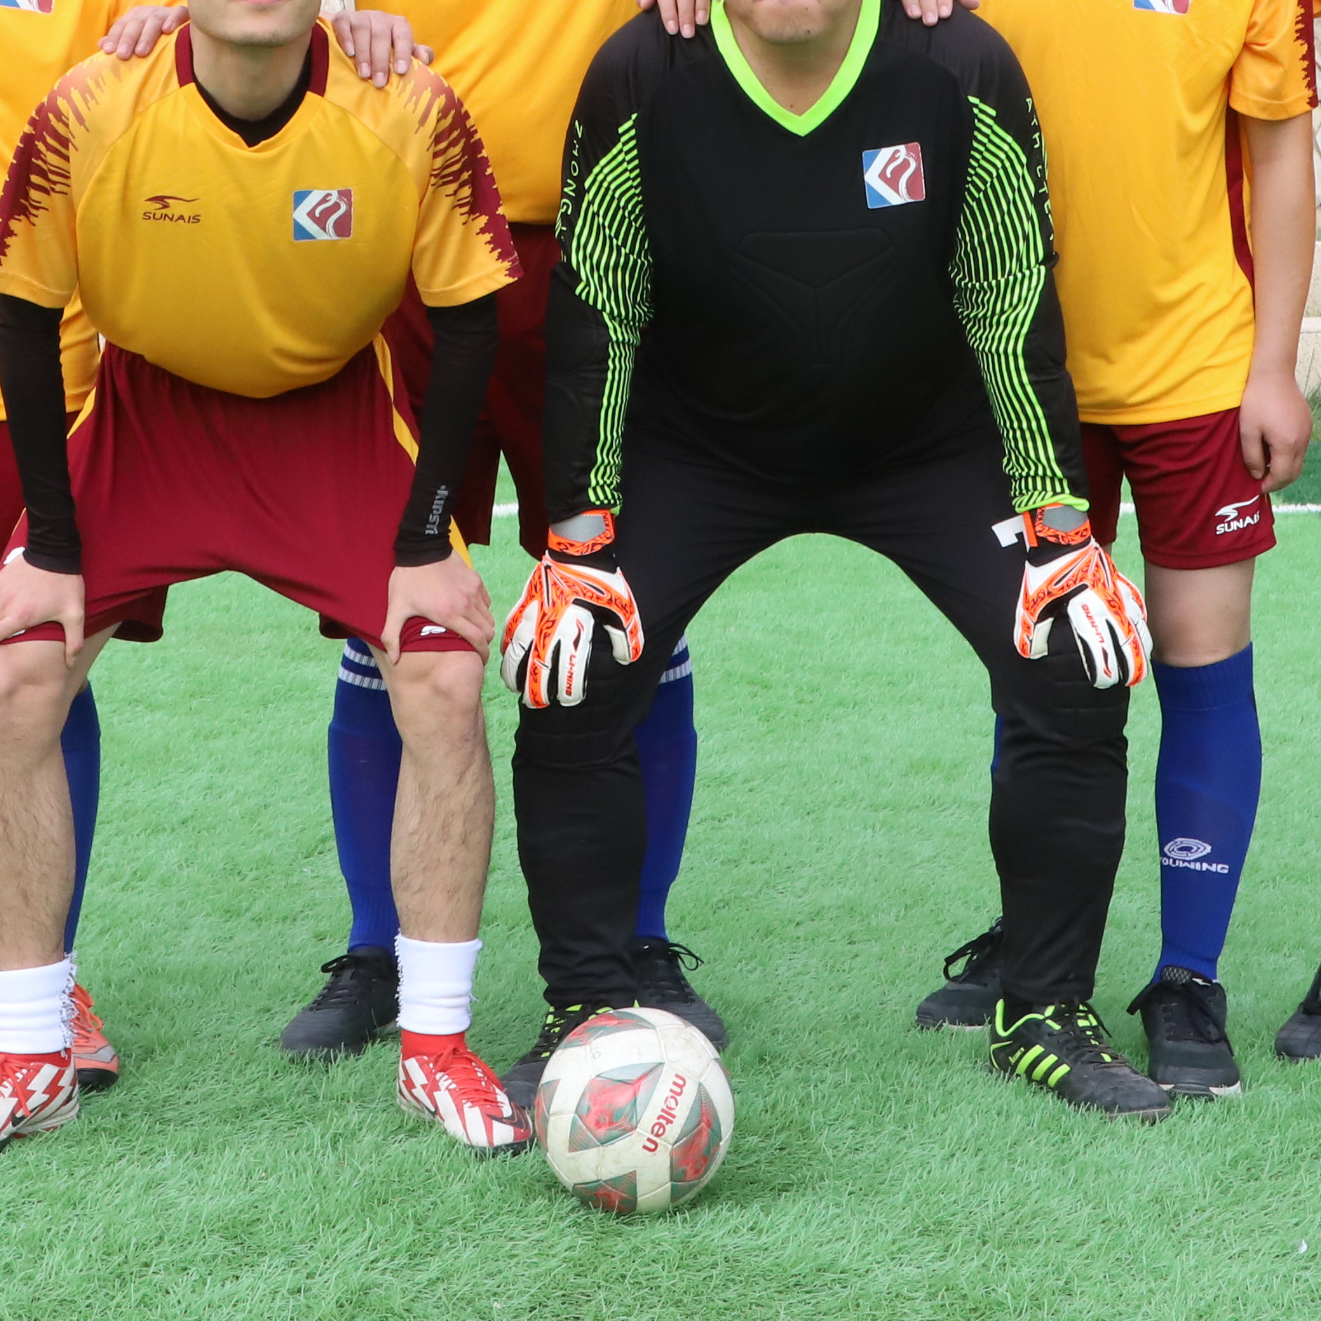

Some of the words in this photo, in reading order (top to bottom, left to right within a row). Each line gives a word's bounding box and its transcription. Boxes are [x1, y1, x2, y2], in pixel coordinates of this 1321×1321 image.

[142, 211, 201, 224] SUNAIS
[565, 653, 577, 697] LI-NING
[1160, 857, 1230, 874] OUWING
[641, 1073, 686, 1153] molten
